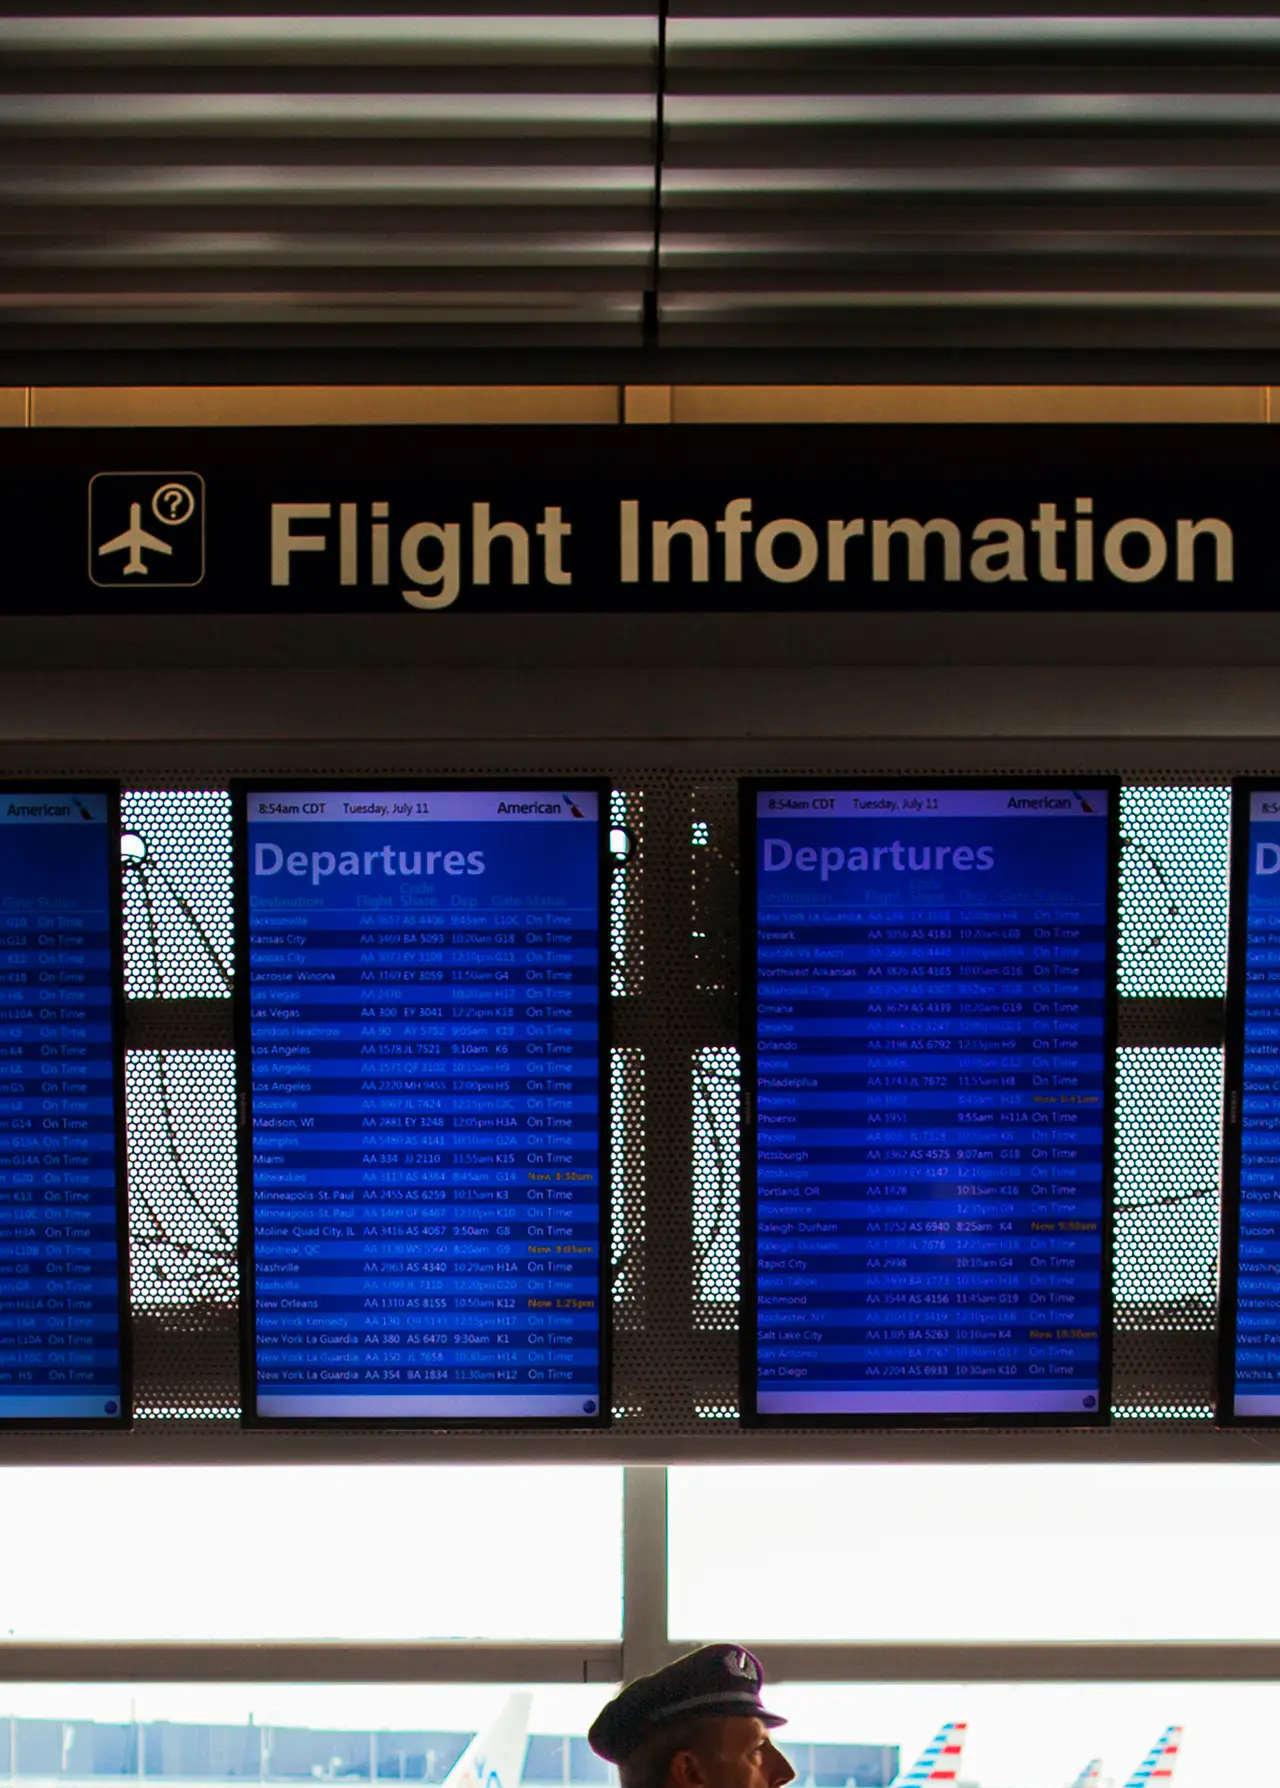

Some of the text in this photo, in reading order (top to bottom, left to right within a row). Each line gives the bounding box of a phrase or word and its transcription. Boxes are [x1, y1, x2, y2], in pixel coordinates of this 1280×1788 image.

[270, 498, 1235, 609] Flight Information
[498, 802, 561, 814] American
[769, 799, 938, 812] 8:54am CDT Tuesday, July 11
[1008, 797, 1071, 809] American
[7, 804, 70, 816] American
[259, 803, 428, 816] 8:54am CDT Tuesday, July 11
[254, 843, 485, 885] Departures
[764, 839, 994, 881] Departures
[41, 1010, 57, 1019] On
[60, 1010, 85, 1019] Time
[757, 1040, 1078, 1049] Orlando On Time
[253, 1154, 284, 1163] Miami
[363, 1154, 377, 1163] AA
[380, 1154, 398, 1163] 334
[416, 1154, 440, 1163] 2110
[527, 1154, 543, 1163] On
[546, 1154, 572, 1163] Time
[256, 1334, 573, 1344] New York La Guardia AA 380 AS 6470 9:30am K1 On Time
[1237, 1334, 1260, 1344] West
[758, 1366, 1074, 1377] San Diego On Time
